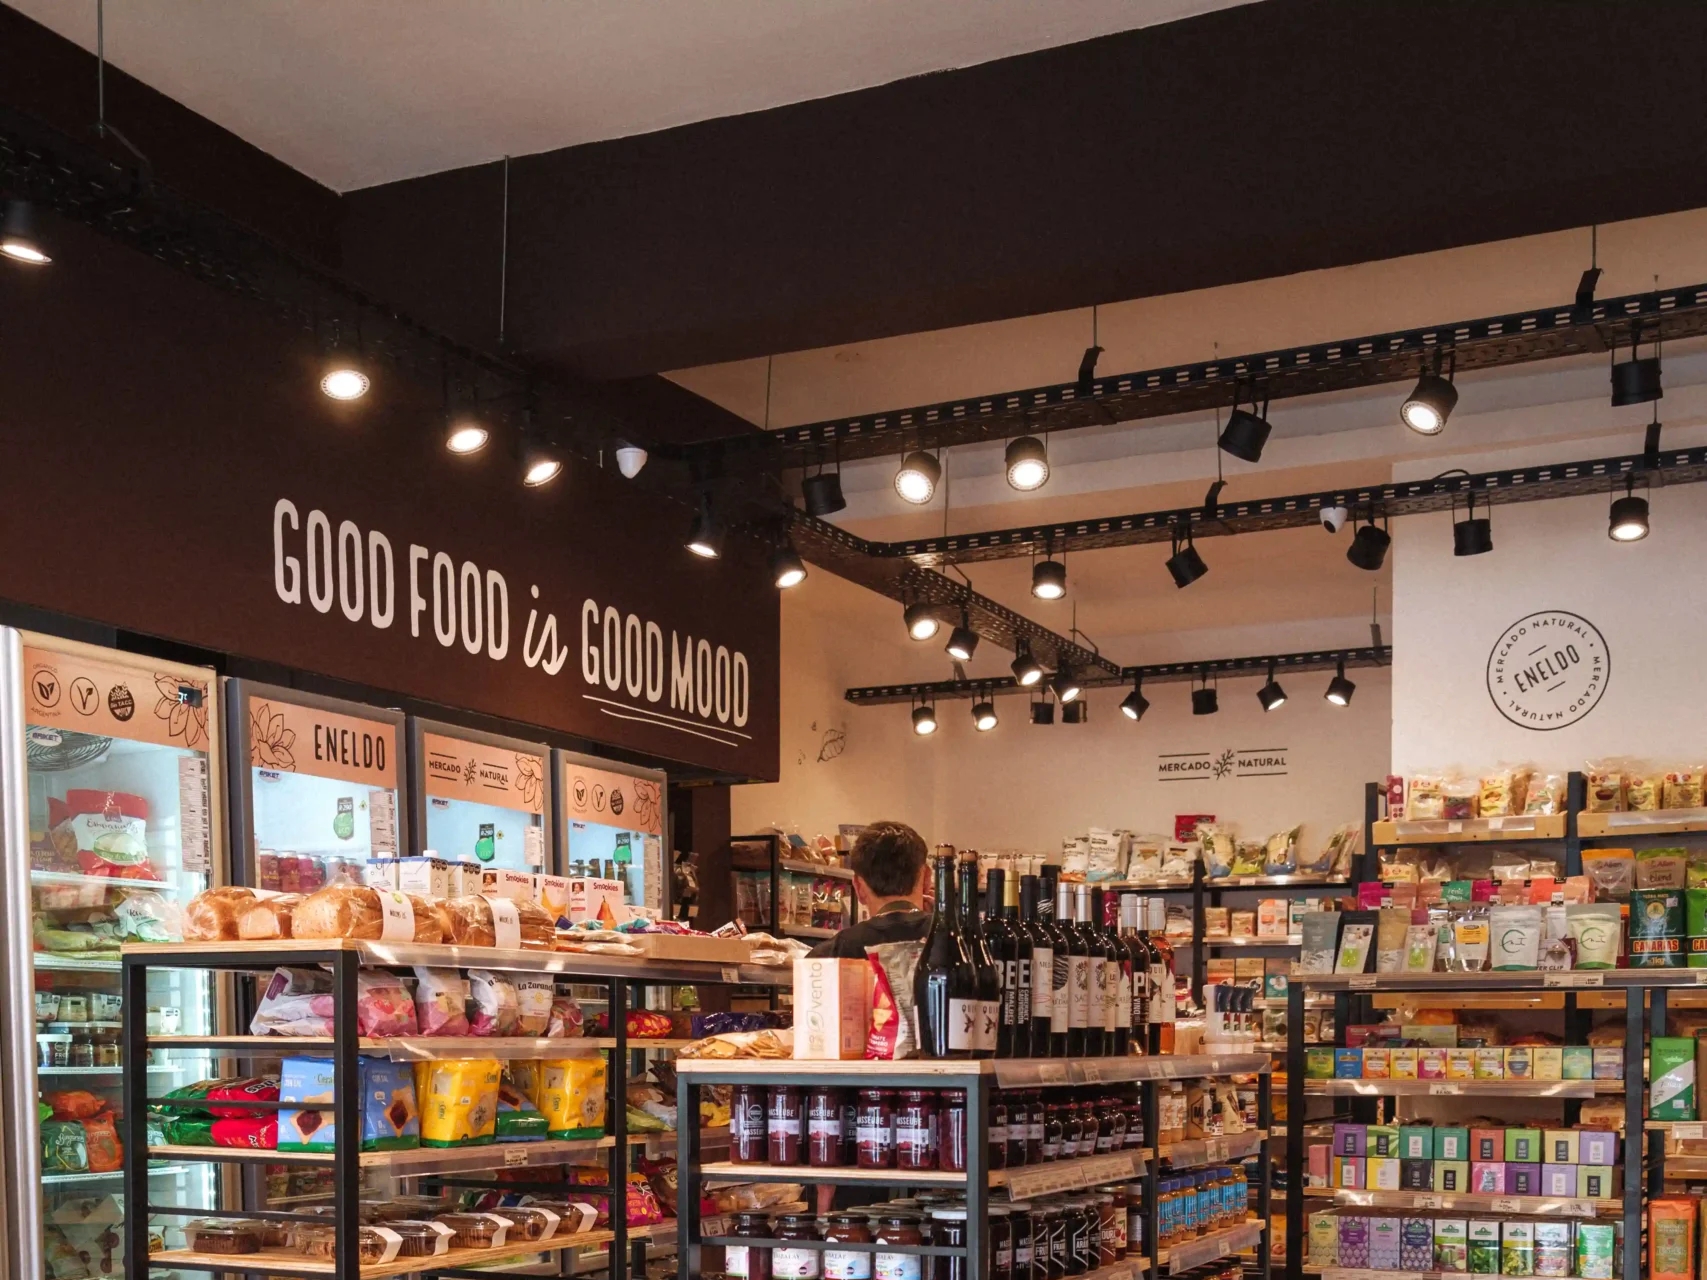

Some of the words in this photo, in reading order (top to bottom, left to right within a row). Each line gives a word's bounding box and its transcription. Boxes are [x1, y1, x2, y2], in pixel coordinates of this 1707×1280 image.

[273, 498, 395, 629] GOOD
[410, 543, 509, 661] FOOD
[523, 584, 568, 676] is
[582, 598, 664, 702] GOOD
[670, 629, 749, 728] MOOD
[1495, 628, 1526, 684] MERCADO
[1532, 618, 1588, 639] NATURAL
[1514, 644, 1580, 693] ENELDO
[1569, 656, 1602, 712] MERCADO
[1509, 700, 1563, 721] NATURAL
[314, 724, 386, 771] ENELDO
[1158, 761, 1211, 772] MERCADO
[1238, 757, 1287, 768] NATURAL
[429, 760, 461, 774] MERCADO
[480, 769, 509, 785] NATURAL
[518, 983, 527, 991] La
[527, 981, 554, 991] Zarand
